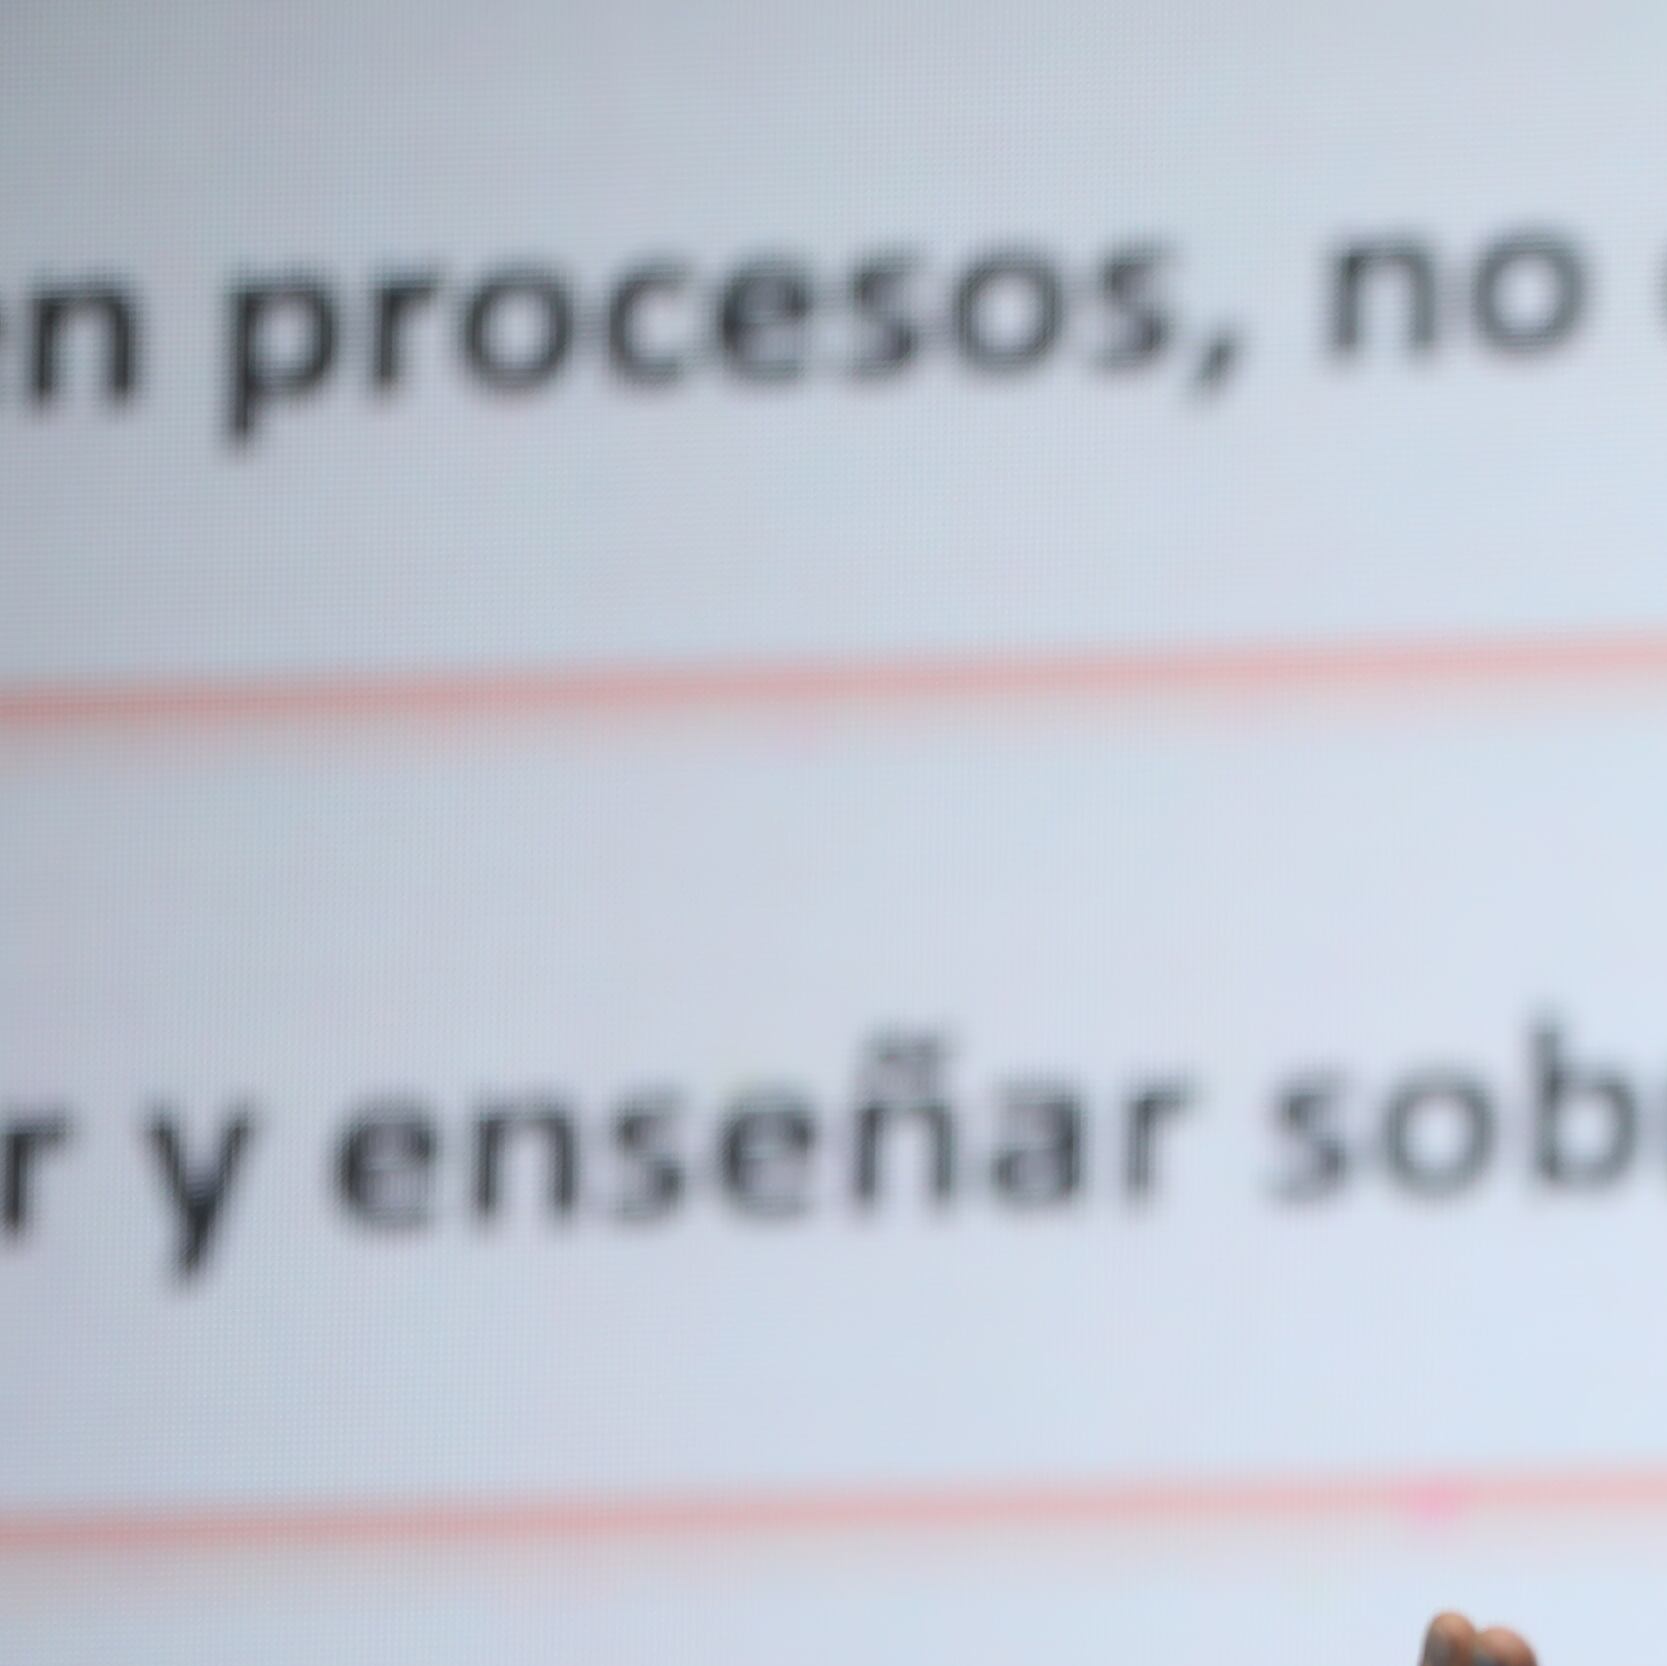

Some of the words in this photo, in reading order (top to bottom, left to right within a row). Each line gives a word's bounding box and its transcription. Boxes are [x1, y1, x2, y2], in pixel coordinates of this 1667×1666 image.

[216, 228, 1238, 456] procesos,
[1320, 224, 1594, 362] no
[142, 1108, 256, 1282] y
[324, 1028, 1188, 1238] enseñar
